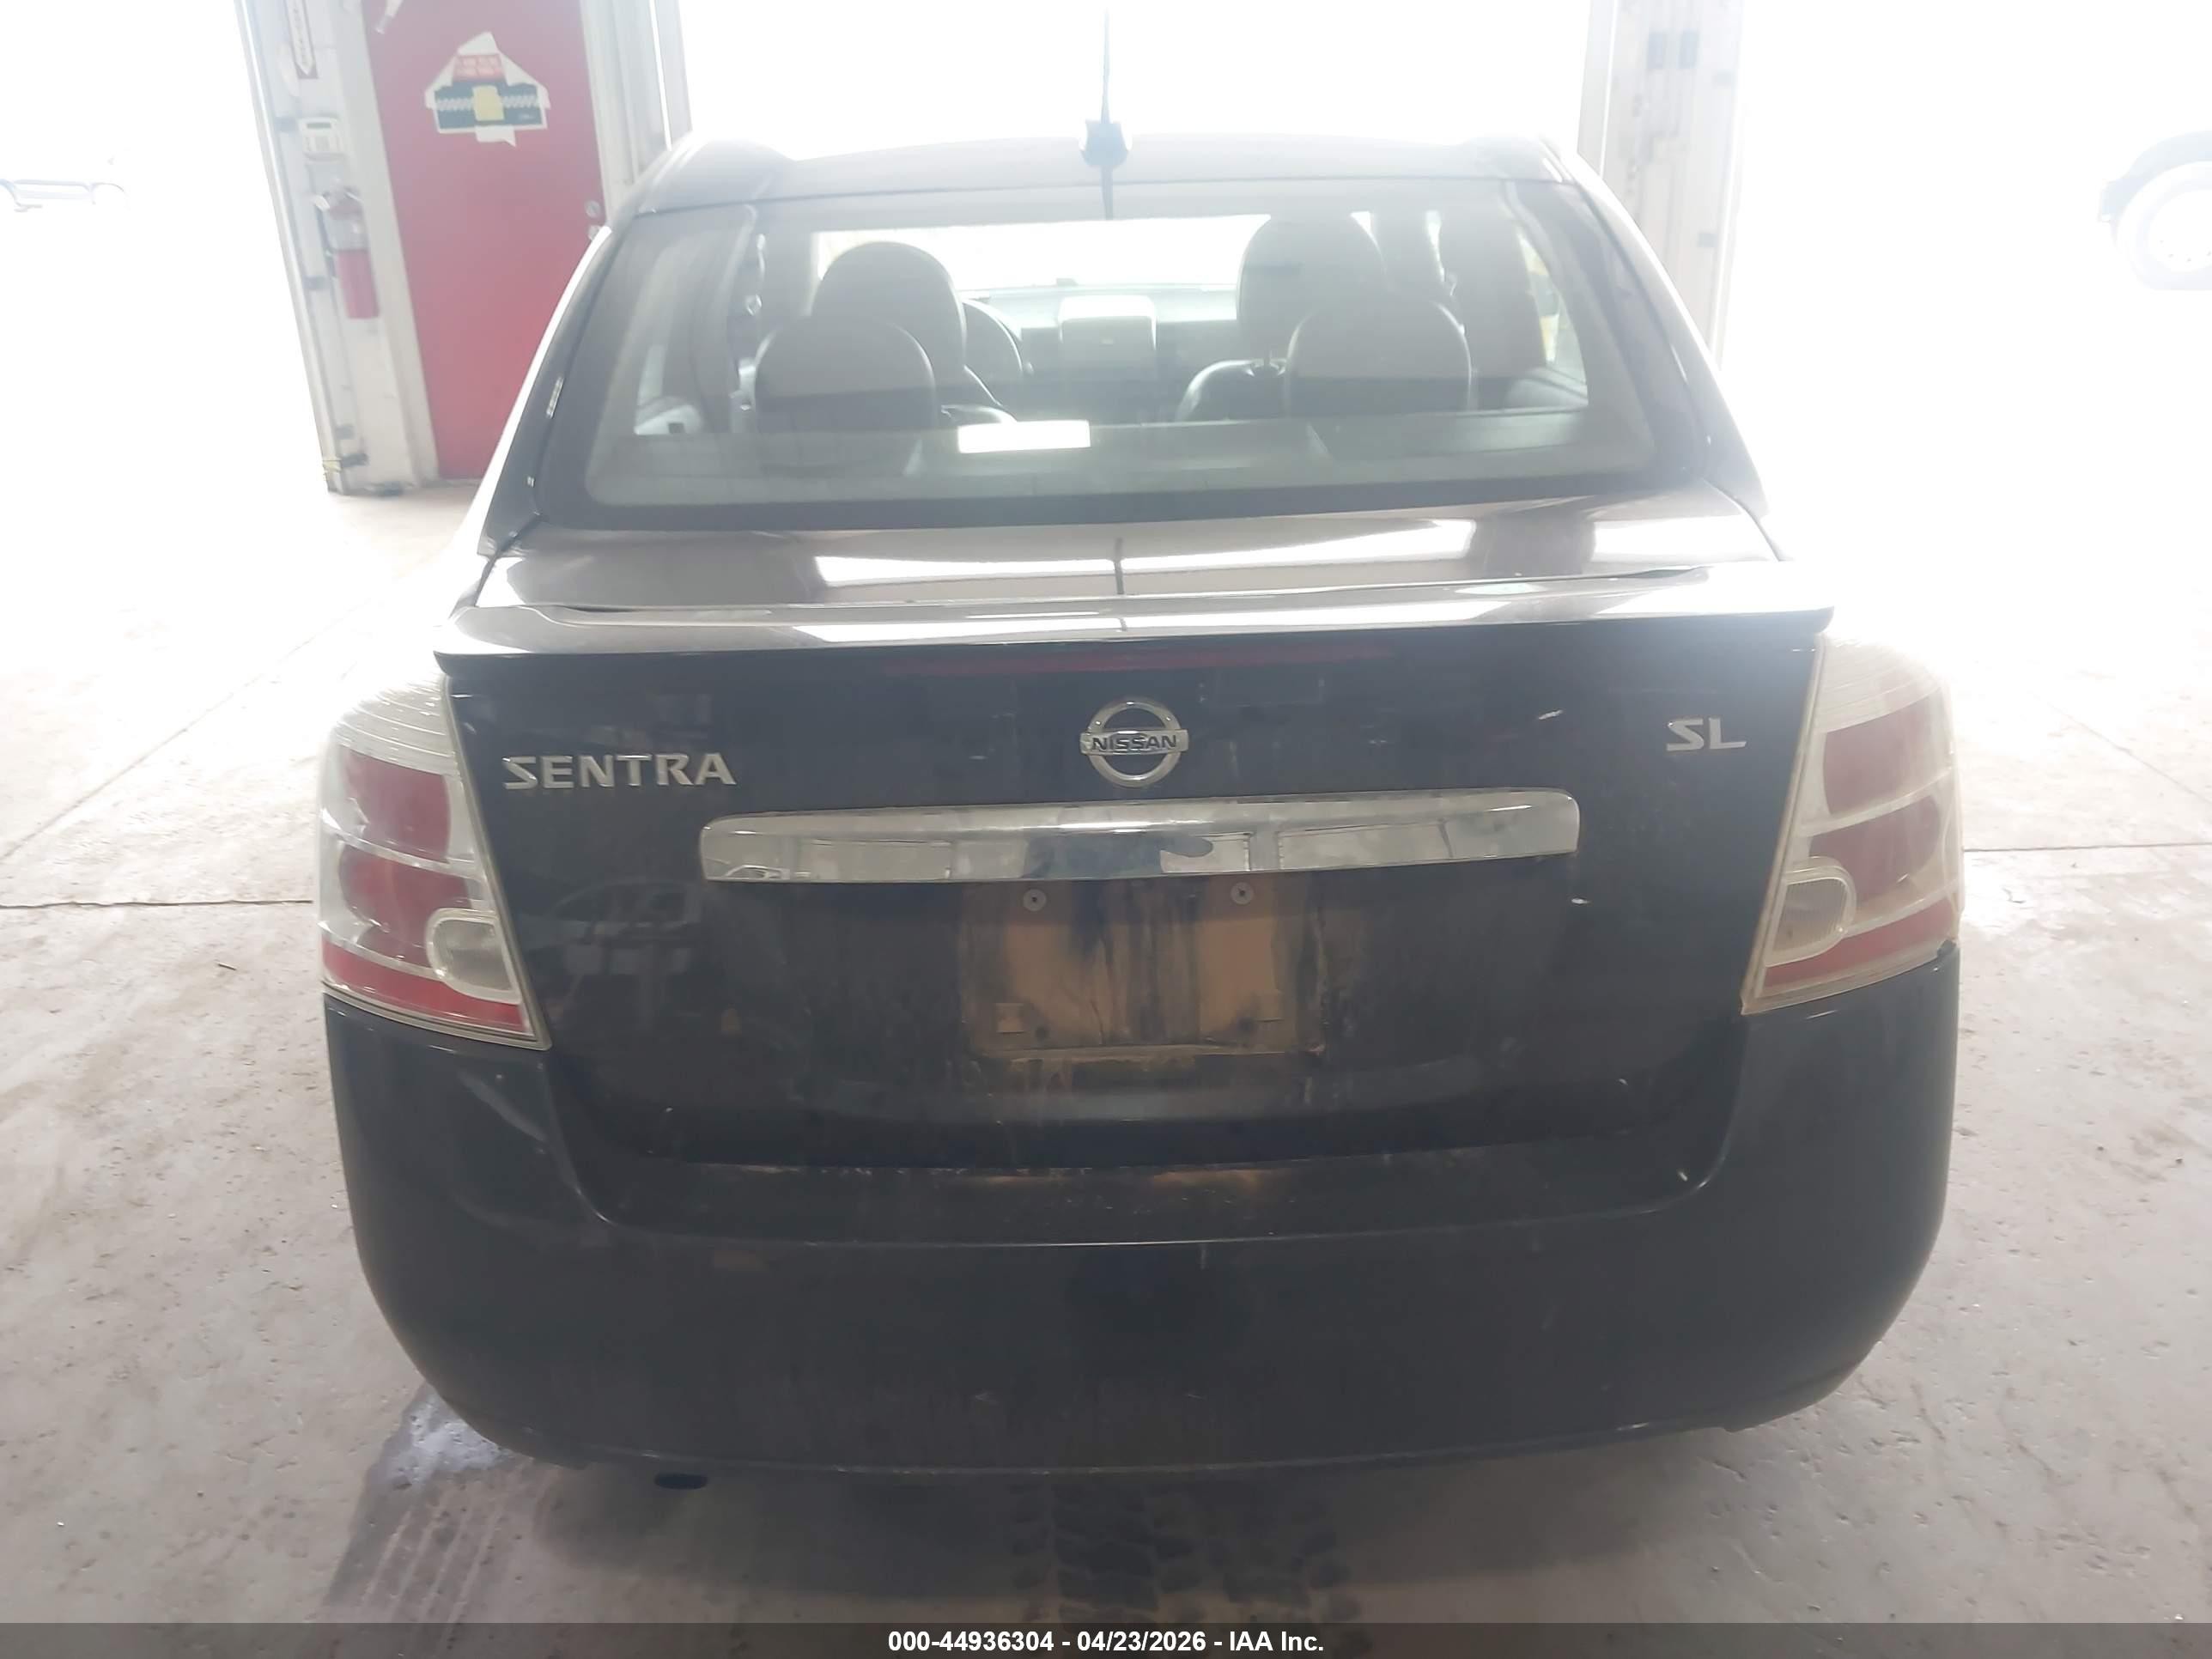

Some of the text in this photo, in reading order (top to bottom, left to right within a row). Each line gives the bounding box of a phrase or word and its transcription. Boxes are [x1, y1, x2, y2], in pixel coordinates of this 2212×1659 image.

[1091, 735, 1176, 750] NISSAN
[1667, 717, 1747, 751] SL
[501, 752, 738, 790] SENTRA
